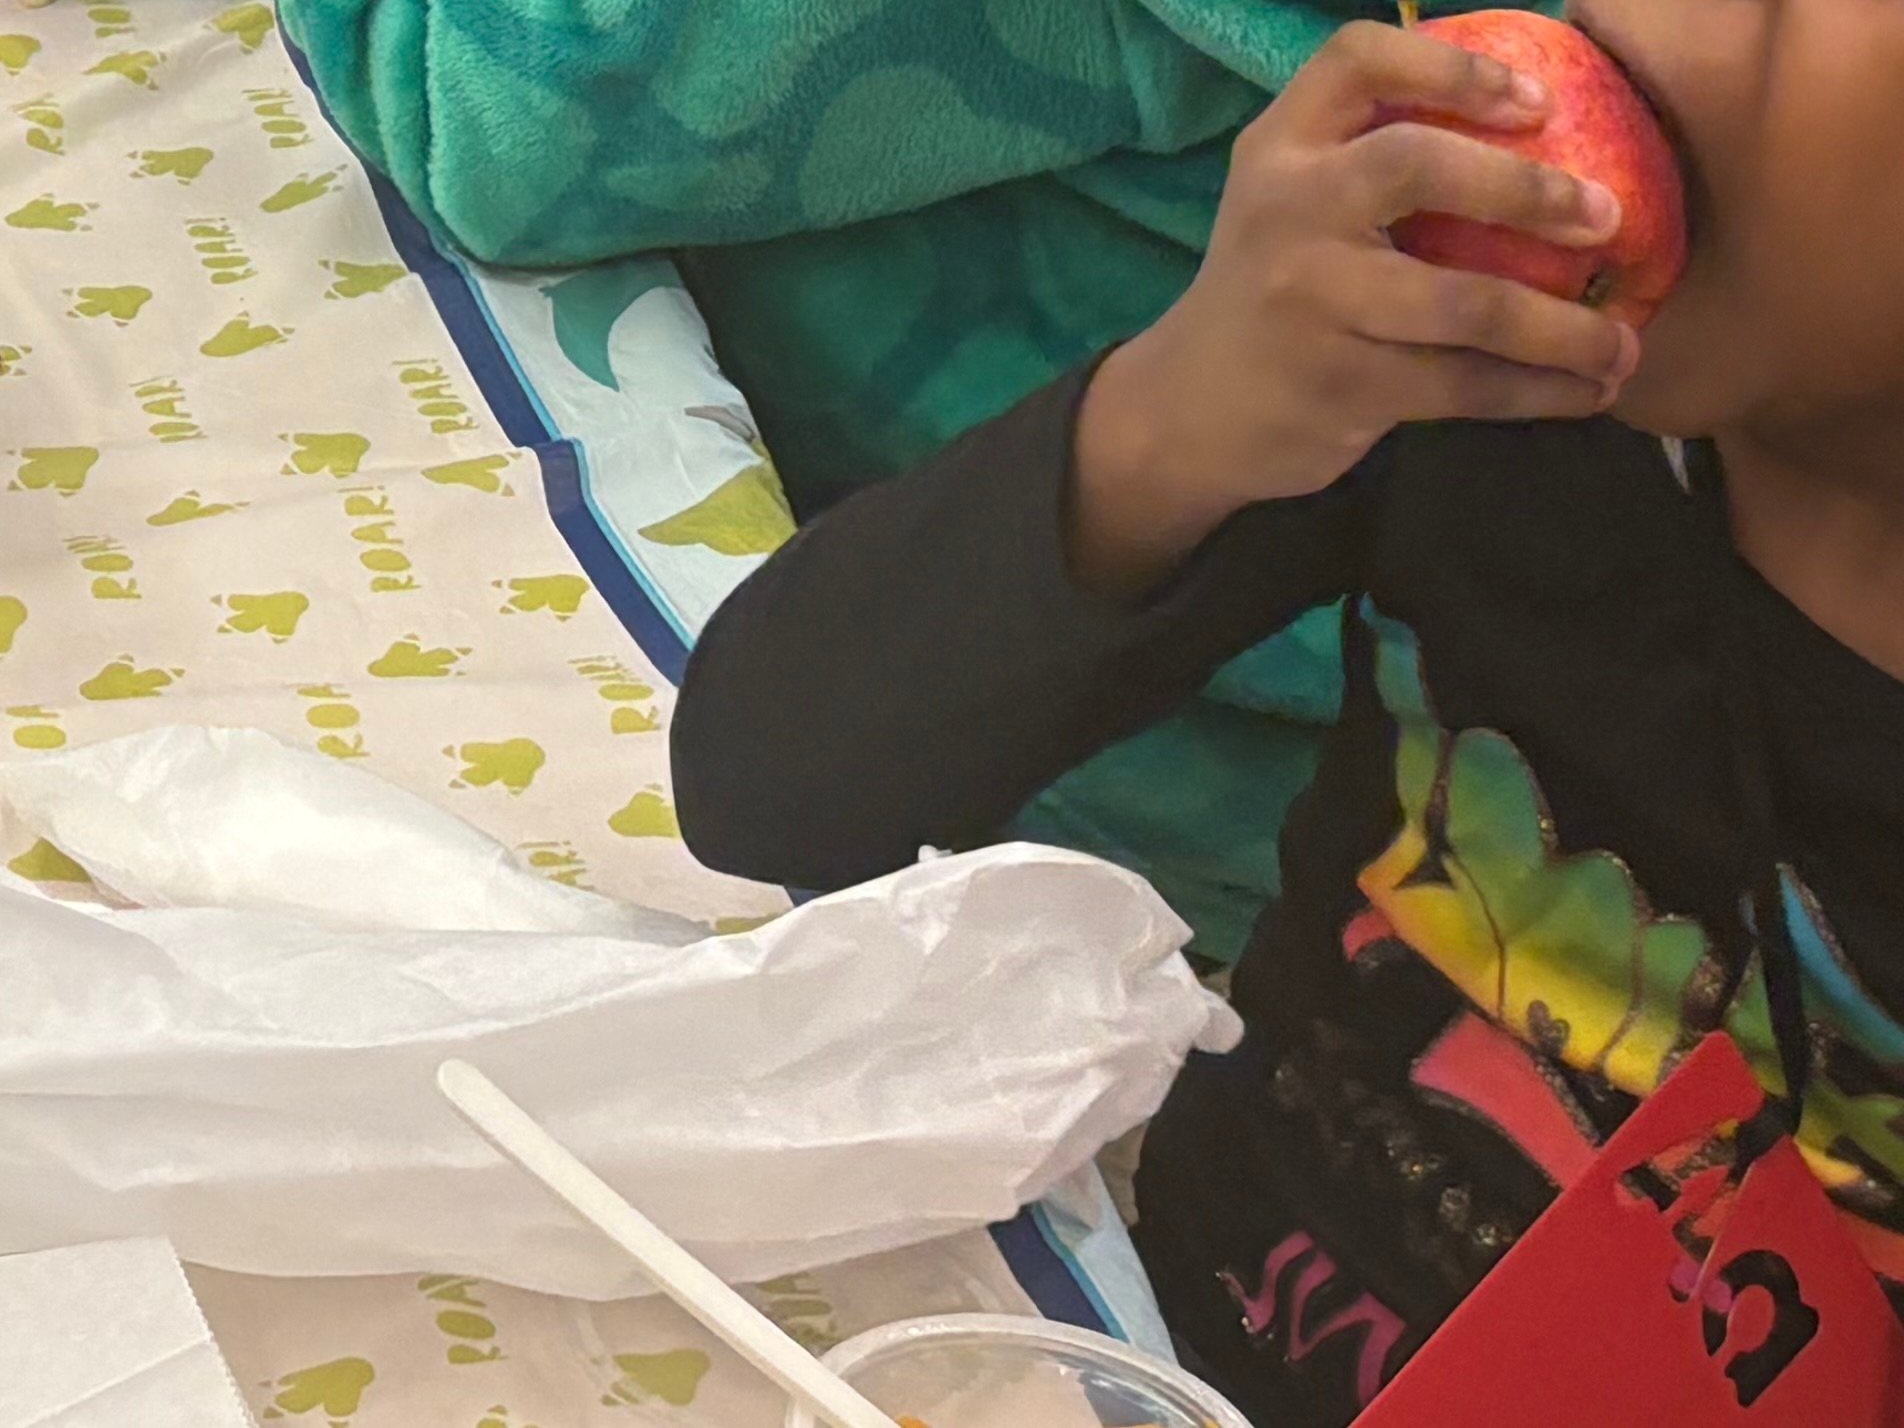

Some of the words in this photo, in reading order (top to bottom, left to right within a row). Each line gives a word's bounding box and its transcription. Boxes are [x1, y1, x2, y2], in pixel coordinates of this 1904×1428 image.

[185, 214, 259, 288] ROAR!
[395, 355, 479, 437] ROAR!
[341, 483, 423, 597] ROAR!
